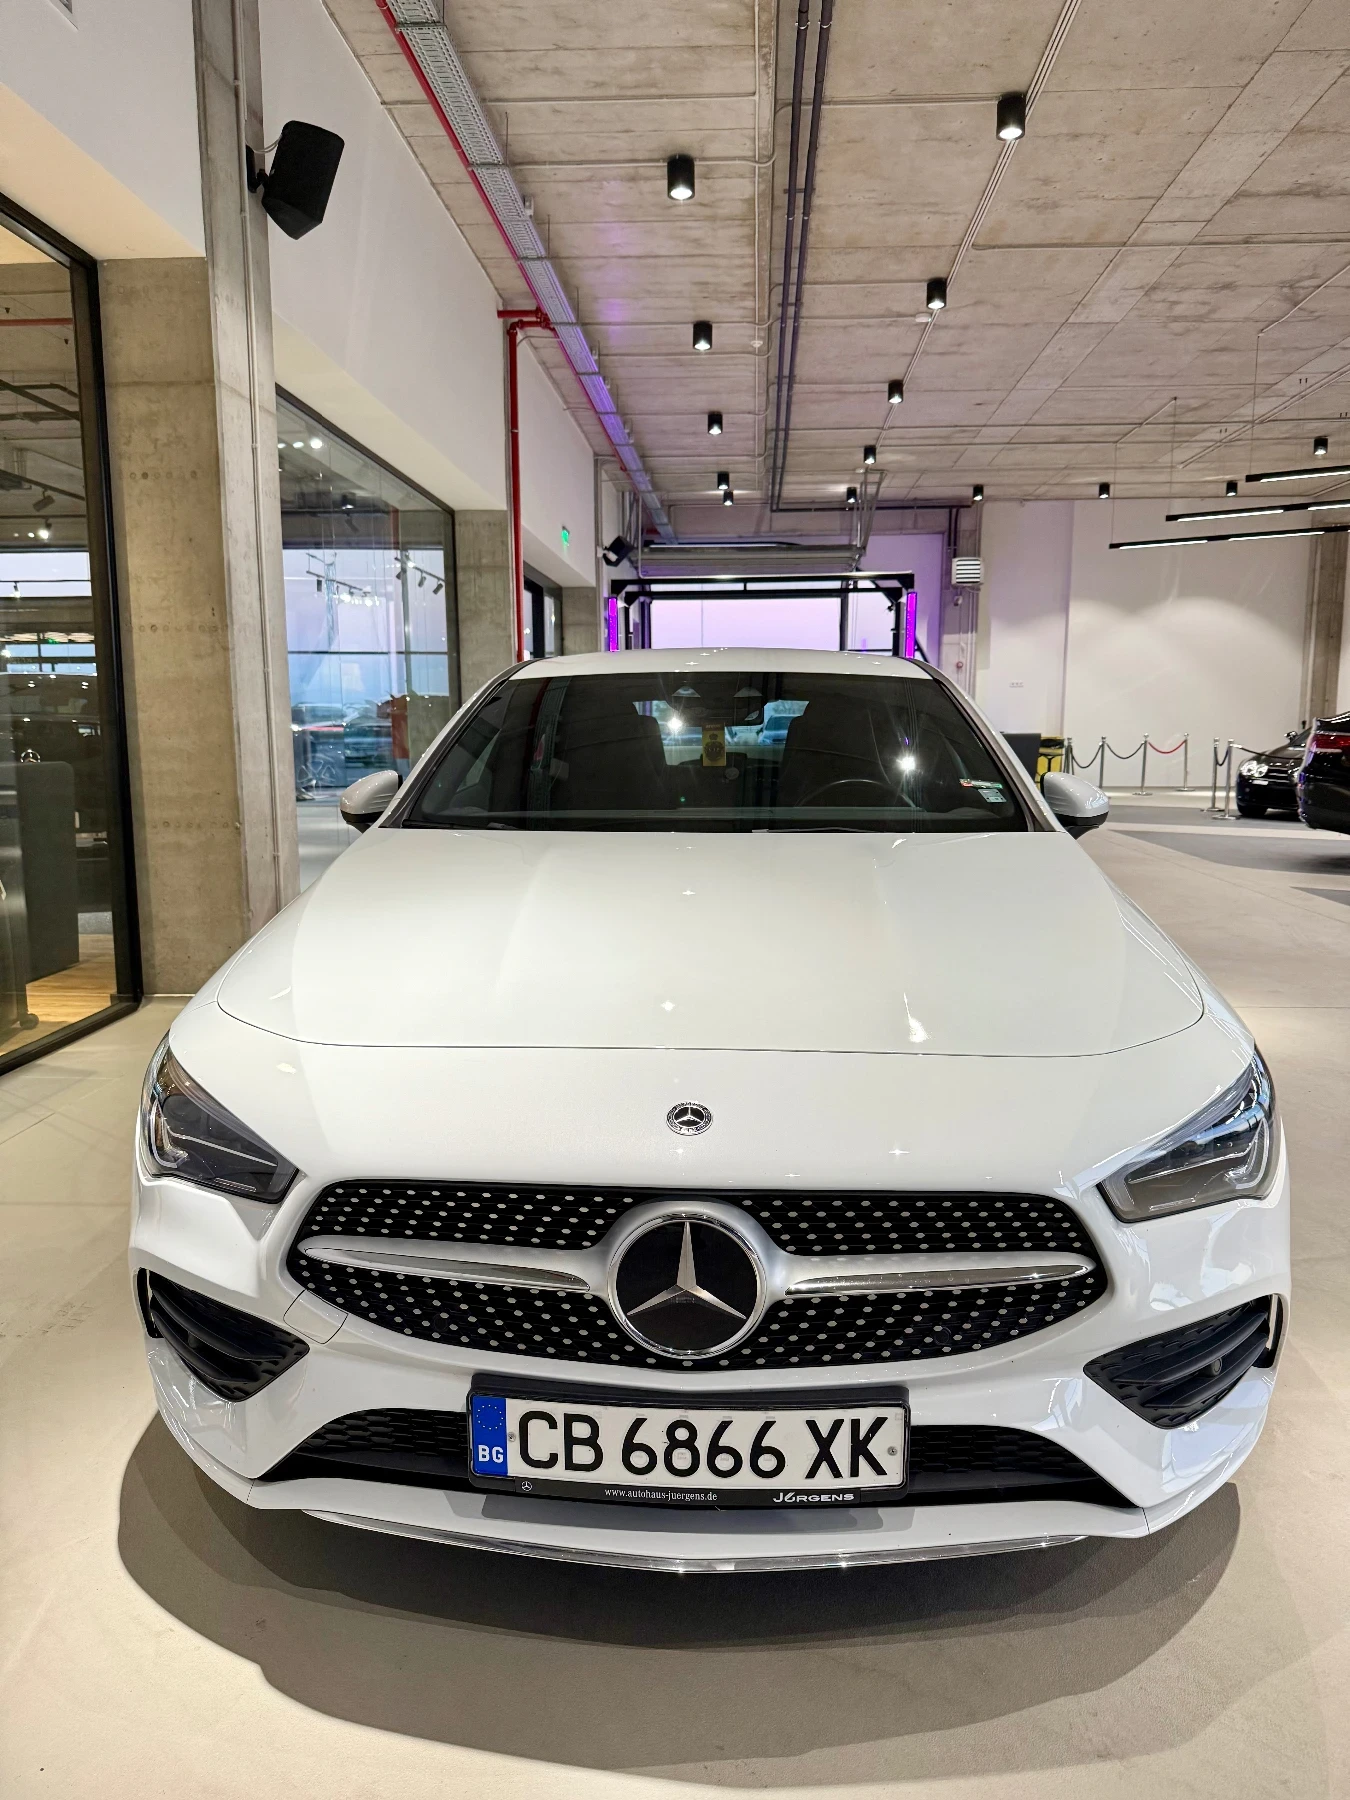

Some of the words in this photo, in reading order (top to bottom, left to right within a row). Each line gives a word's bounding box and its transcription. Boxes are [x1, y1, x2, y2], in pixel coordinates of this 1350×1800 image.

[478, 1444, 504, 1464] BG
[518, 1410, 604, 1472] CB
[621, 1417, 786, 1479] 6866
[805, 1416, 889, 1479] XK
[604, 1488, 718, 1502] www.autohaus-juergens.de
